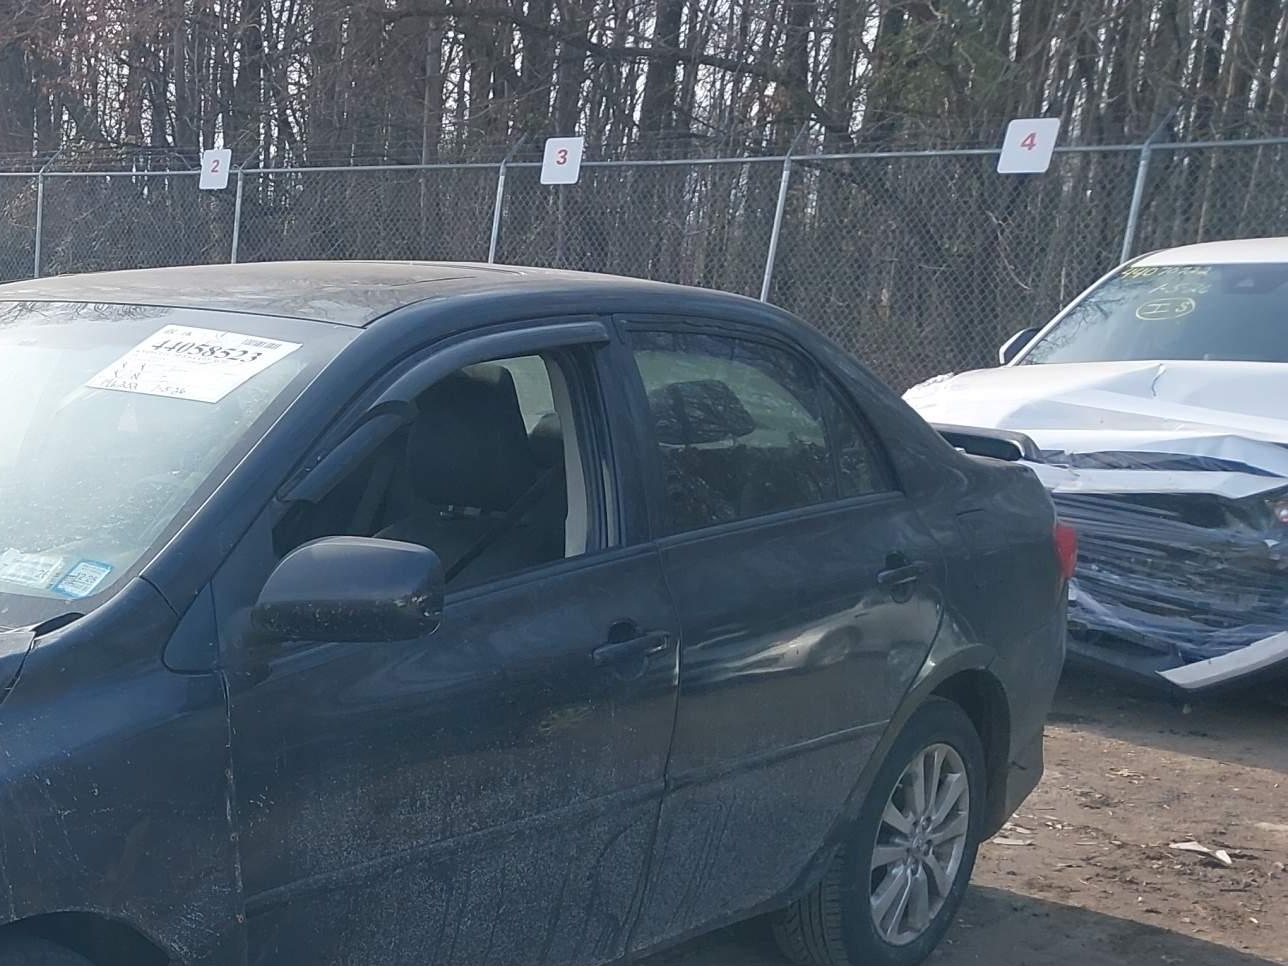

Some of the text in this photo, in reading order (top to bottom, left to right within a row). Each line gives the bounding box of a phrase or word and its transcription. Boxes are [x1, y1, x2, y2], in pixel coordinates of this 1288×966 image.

[1020, 132, 1037, 151] 4
[555, 149, 569, 165] 3
[211, 160, 221, 174] 2
[151, 340, 263, 362] 44058523
